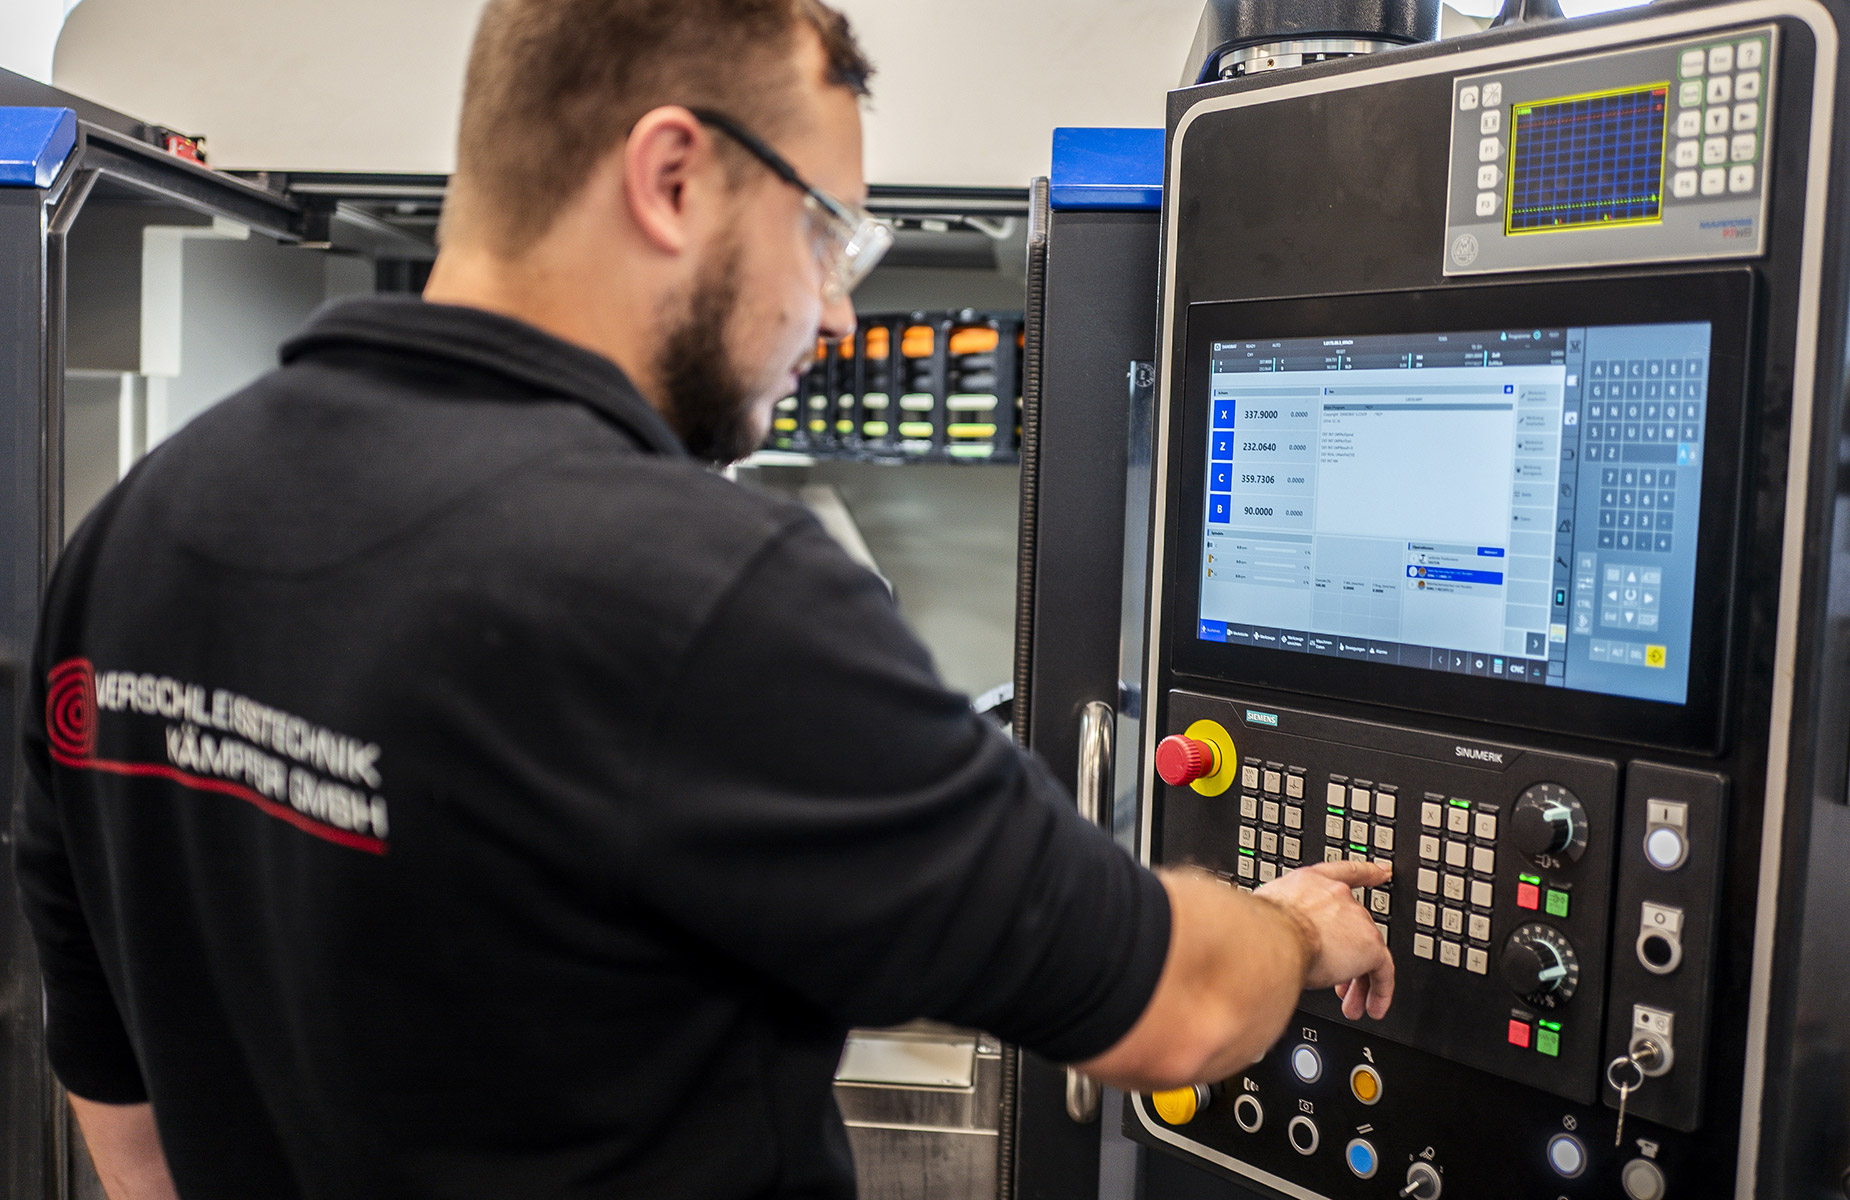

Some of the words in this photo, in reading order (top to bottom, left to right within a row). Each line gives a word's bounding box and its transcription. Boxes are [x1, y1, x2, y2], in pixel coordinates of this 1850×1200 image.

[1595, 365, 1602, 375] A
[1632, 364, 1638, 375] C
[1651, 364, 1658, 375] D
[1671, 363, 1676, 375] E
[1594, 386, 1600, 396] G
[1612, 386, 1619, 396] H
[1221, 410, 1227, 419] X
[1245, 411, 1278, 419] 337.9000
[1592, 406, 1600, 416] M
[1611, 406, 1618, 416] N
[1649, 406, 1655, 416] P
[1667, 406, 1675, 418] Q
[1592, 427, 1597, 437] S
[1610, 426, 1615, 437] T
[1628, 427, 1635, 437] U
[1647, 427, 1654, 438] V
[1665, 427, 1674, 438] W
[1686, 427, 1693, 438] X
[1220, 442, 1225, 451] Z
[1243, 443, 1276, 451] 232.0640
[1591, 447, 1597, 457] Y
[1609, 447, 1615, 458] Z
[1218, 474, 1224, 482] C
[1241, 475, 1275, 483] 359.7306
[1608, 472, 1613, 482] 7
[1645, 473, 1651, 483] 9
[1606, 493, 1612, 503] 4
[1217, 505, 1222, 513] B
[1244, 507, 1273, 516] 90.0000
[1606, 513, 1610, 524] 1
[1623, 514, 1629, 525] 2
[1642, 515, 1648, 526] 3
[1621, 535, 1628, 546] 0
[1510, 664, 1524, 674] CNC
[1247, 712, 1276, 723] SIEMENS
[95, 671, 382, 789] VERSCHLEISSTECHNIK
[1455, 746, 1503, 763] SINUMERIK
[165, 721, 289, 800] KÄMPFER
[1427, 811, 1434, 820] X
[1454, 816, 1461, 824] Z
[1426, 844, 1432, 853] B
